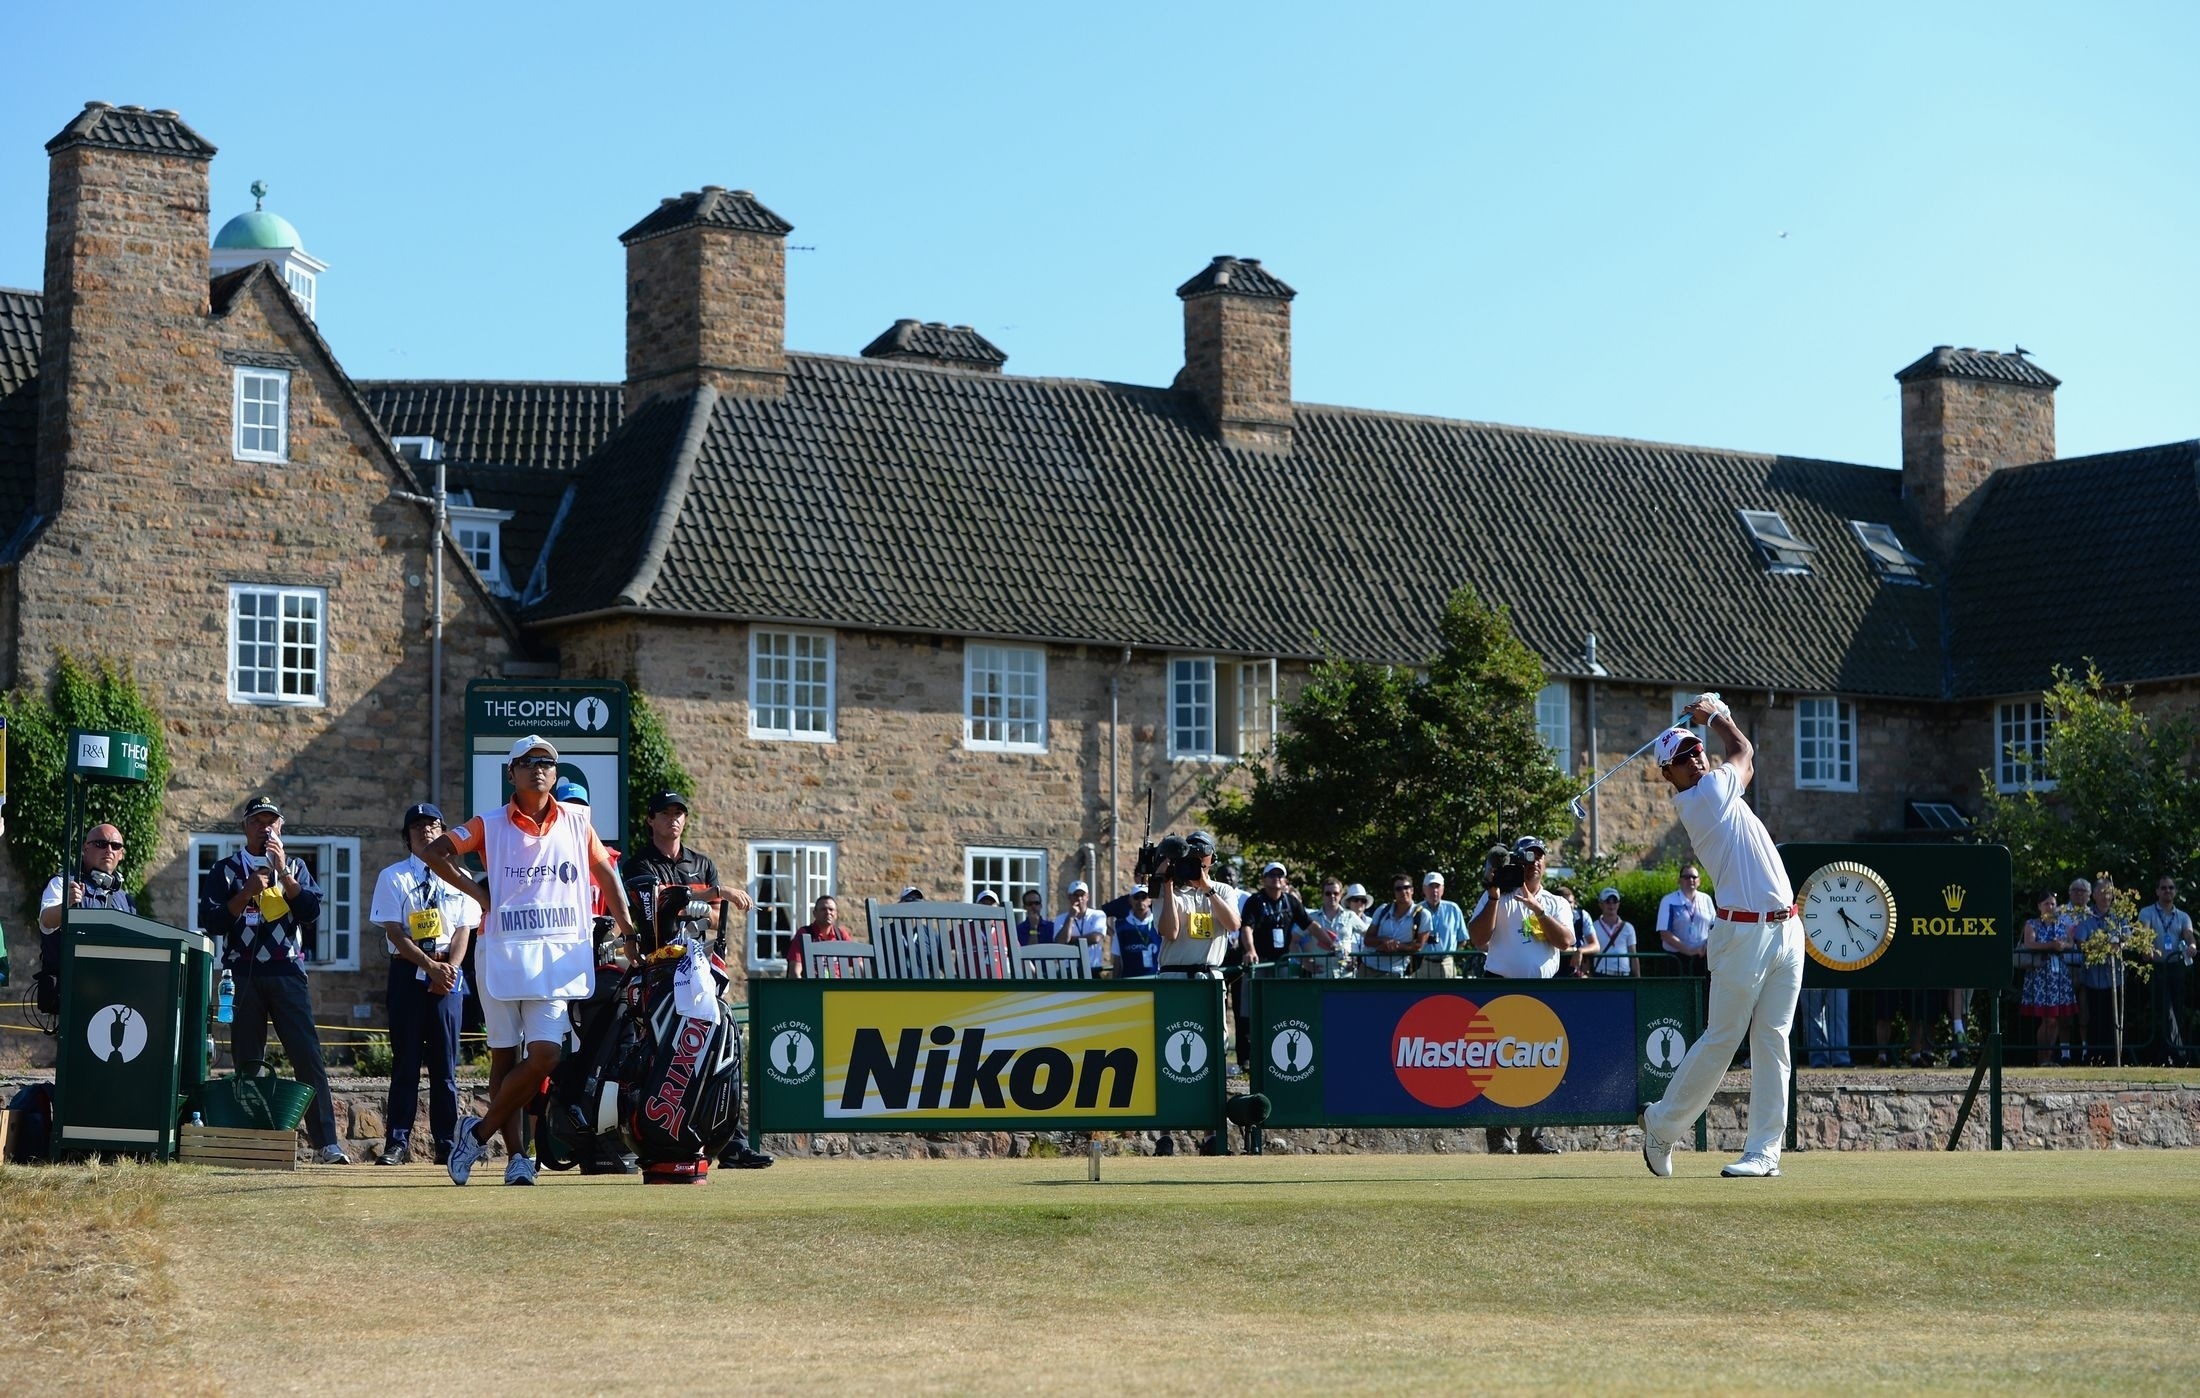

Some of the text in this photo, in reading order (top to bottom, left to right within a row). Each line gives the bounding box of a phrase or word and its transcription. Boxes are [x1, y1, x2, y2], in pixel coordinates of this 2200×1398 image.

[82, 743, 105, 759] R&A
[640, 890, 652, 921] SRIXON
[1830, 895, 1857, 903] ROLEX
[501, 907, 577, 932] MATSUYAMA
[1911, 917, 1997, 936] ROLEX
[772, 1020, 811, 1033] THE OPEN
[1166, 1020, 1204, 1033] THE OPEN
[1272, 1019, 1310, 1032] THE OPEN
[1647, 1017, 1683, 1030] THE OPEN
[1396, 1036, 1564, 1068] MasterCard
[767, 1067, 816, 1085] CHAMPIONSHIP
[840, 1025, 1138, 1110] Nikon
[1162, 1066, 1209, 1084] CHAMPIONSHIP
[1268, 1065, 1315, 1082] CHAMPIONSHIP
[1643, 1062, 1675, 1079] CHAMPIO
